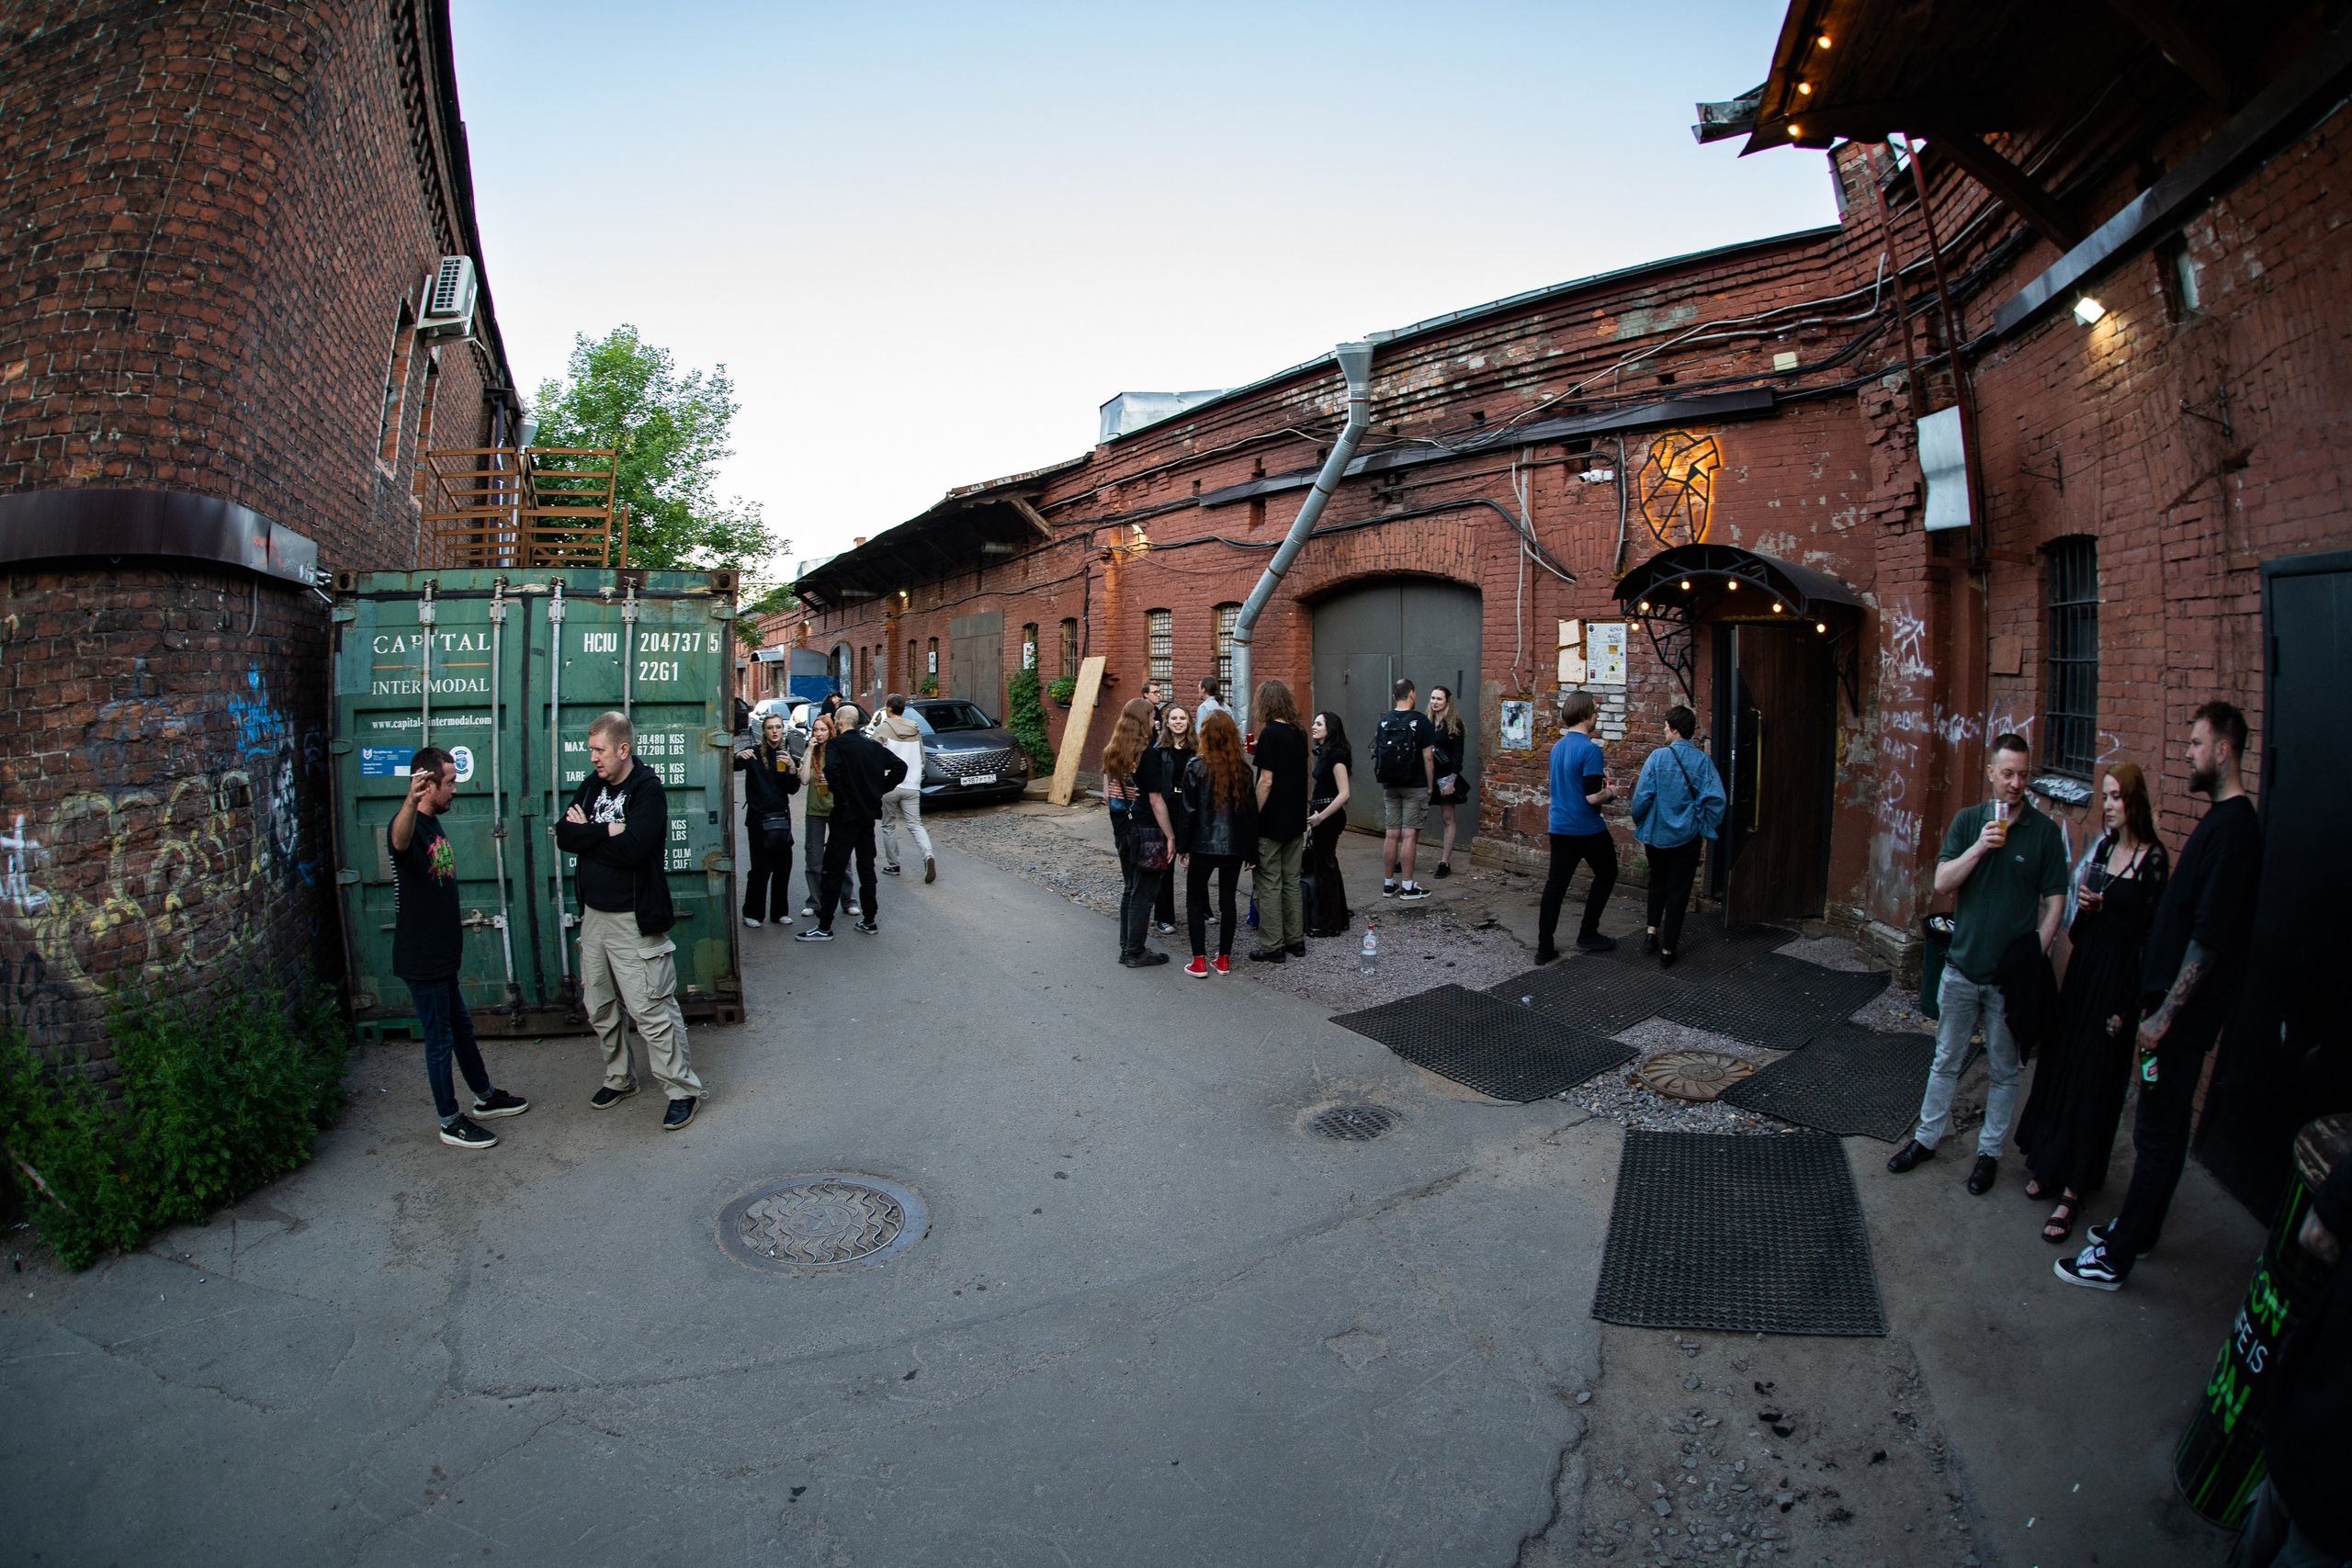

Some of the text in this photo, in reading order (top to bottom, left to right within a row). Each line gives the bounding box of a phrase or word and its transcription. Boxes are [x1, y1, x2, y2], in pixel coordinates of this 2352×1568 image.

[373, 633, 491, 654] CAPITAL
[583, 632, 719, 653] HCIU 204737 5
[639, 661, 679, 682] 22G1
[372, 678, 490, 695] INTERMODAL
[637, 734, 685, 745] 30.480 KGS
[564, 741, 587, 752] MAX.
[637, 745, 684, 756] 67.200 LBS
[669, 762, 685, 773] KGS
[669, 773, 685, 784] LBS
[671, 819, 687, 830] KGS
[672, 830, 687, 841] LBS
